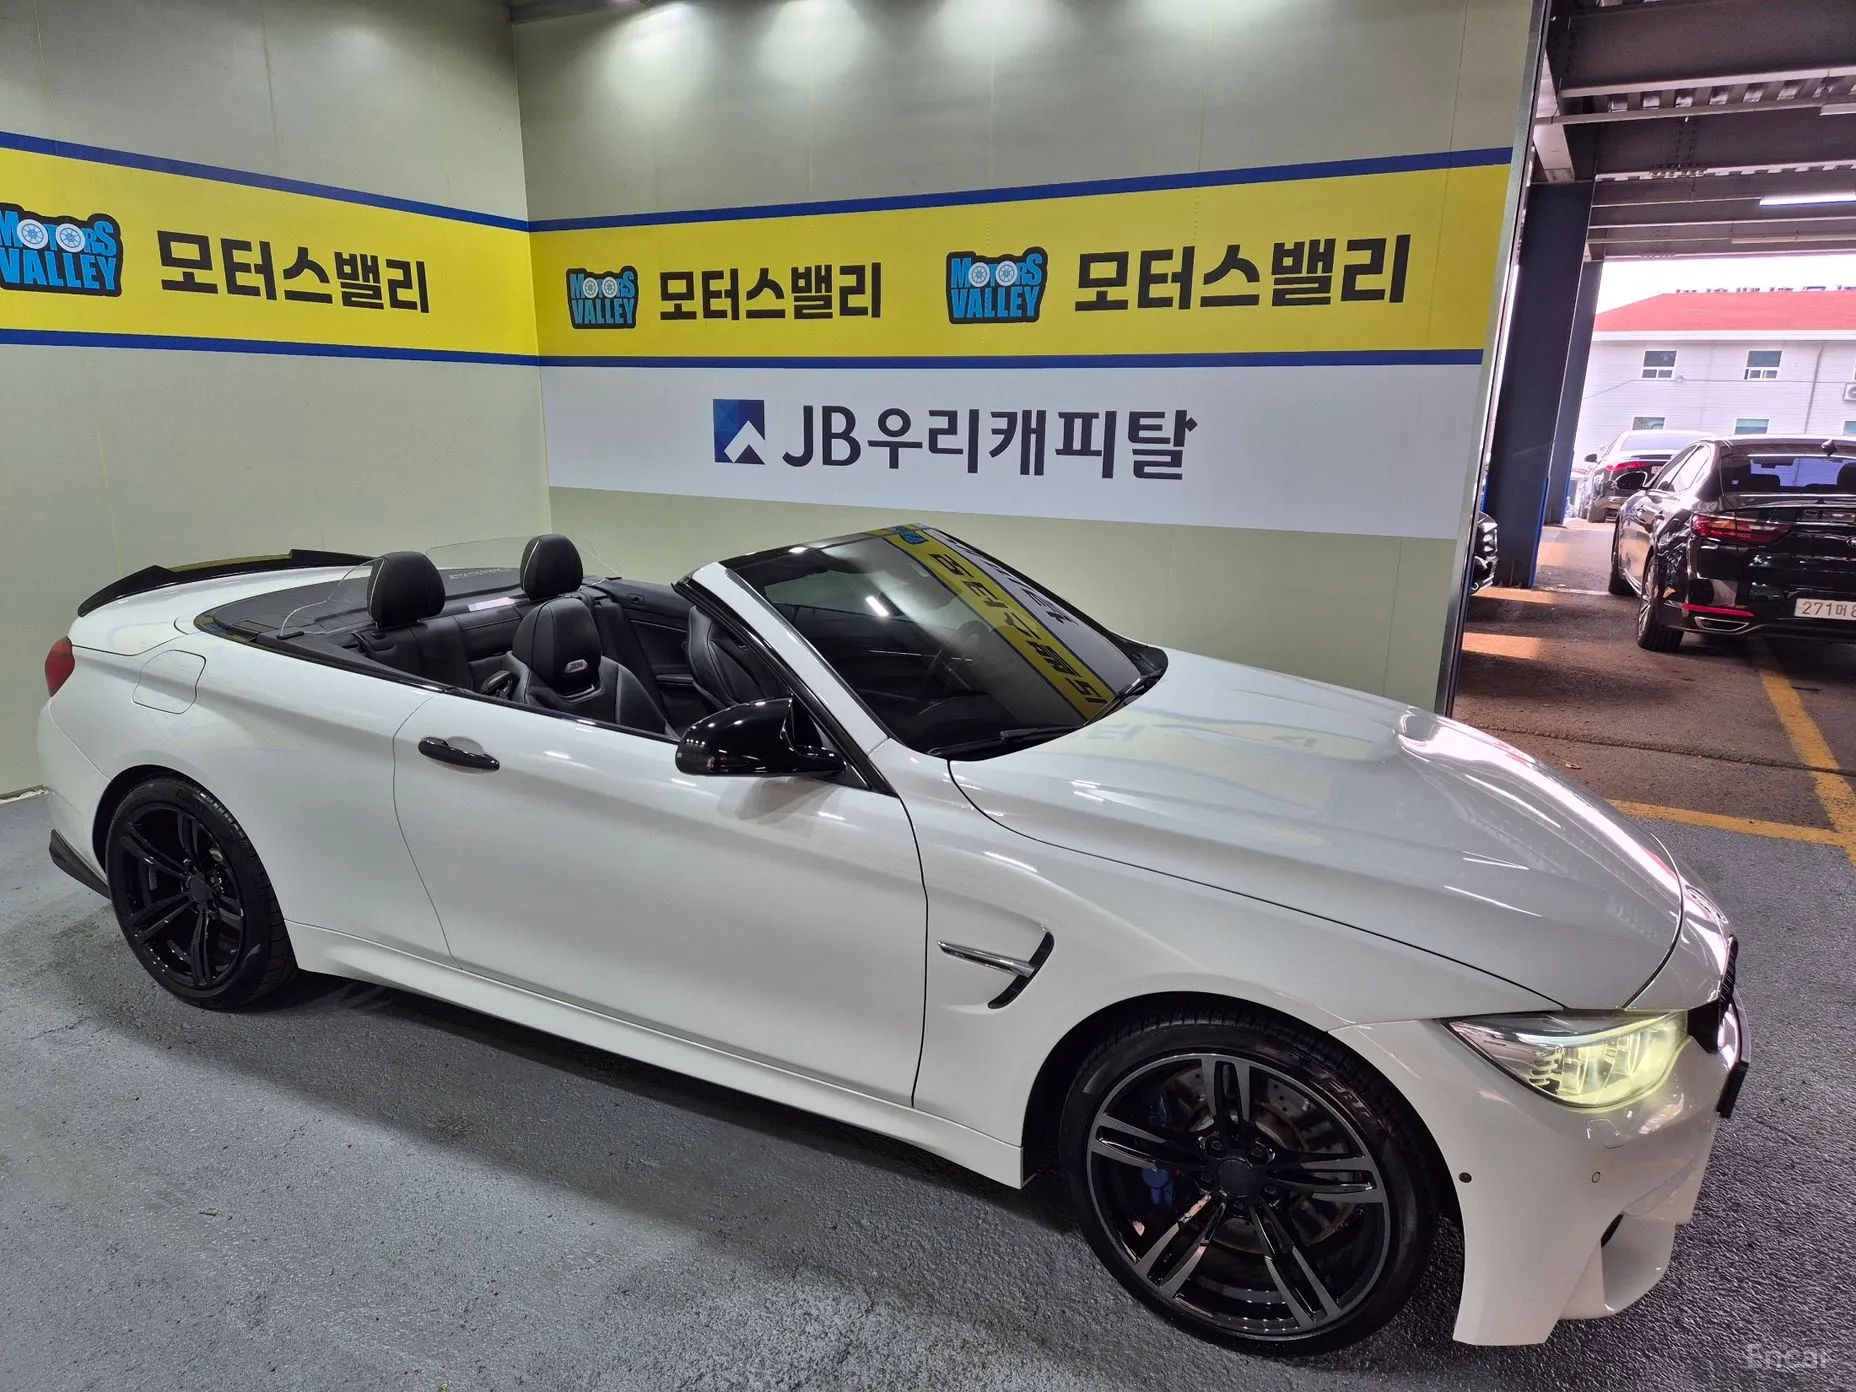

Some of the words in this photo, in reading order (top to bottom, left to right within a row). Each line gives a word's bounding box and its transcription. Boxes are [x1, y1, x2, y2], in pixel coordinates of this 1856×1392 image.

[0, 247, 116, 290] VALLEY
[157, 230, 429, 313] 모터스밸리
[660, 263, 881, 320] 모터스밸리
[1074, 234, 1411, 311] 모터스밸리
[571, 298, 634, 324] VALLEY
[951, 286, 1040, 318] VALLEY
[783, 406, 1197, 481] JB우리캐피탈
